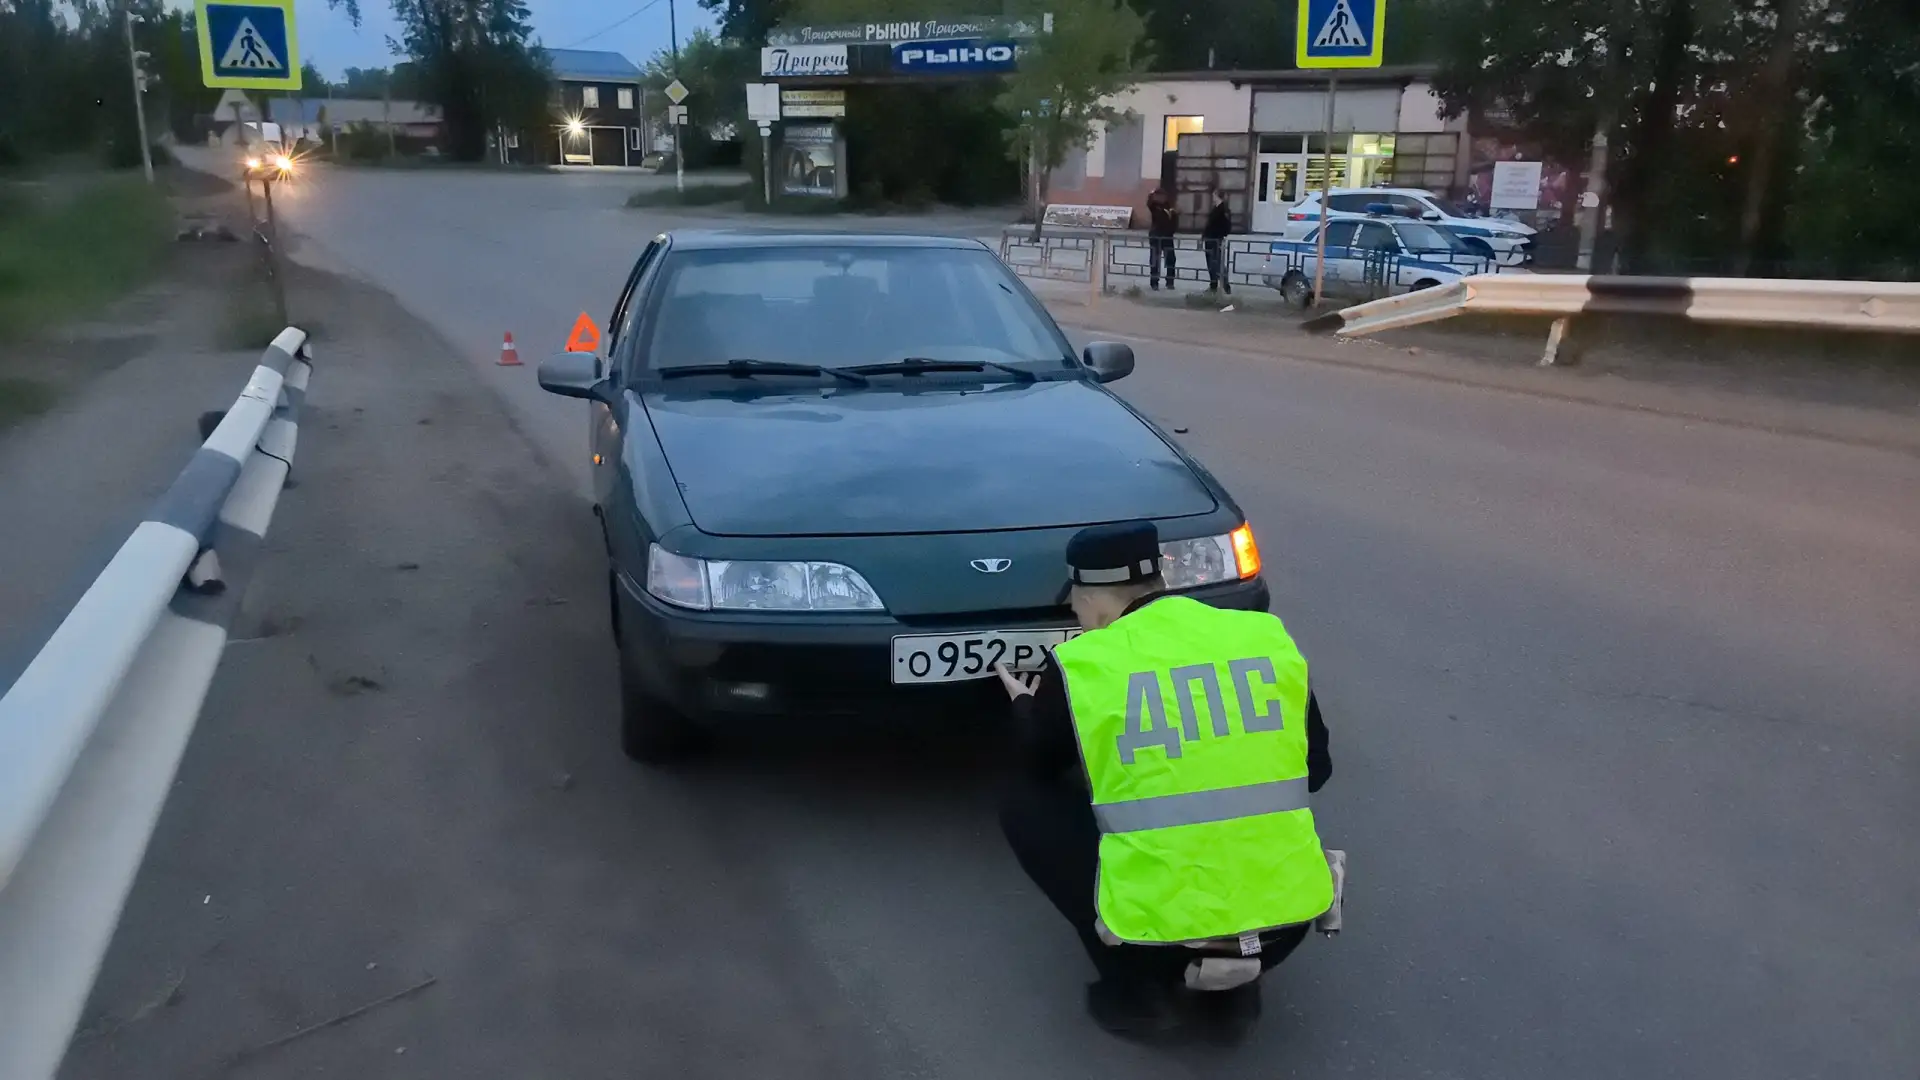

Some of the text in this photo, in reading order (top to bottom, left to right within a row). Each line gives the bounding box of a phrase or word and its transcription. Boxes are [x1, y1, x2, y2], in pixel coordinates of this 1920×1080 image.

[801, 20, 984, 43] Приречный РЫНОК Приречн
[1116, 656, 1284, 765] ДПС
